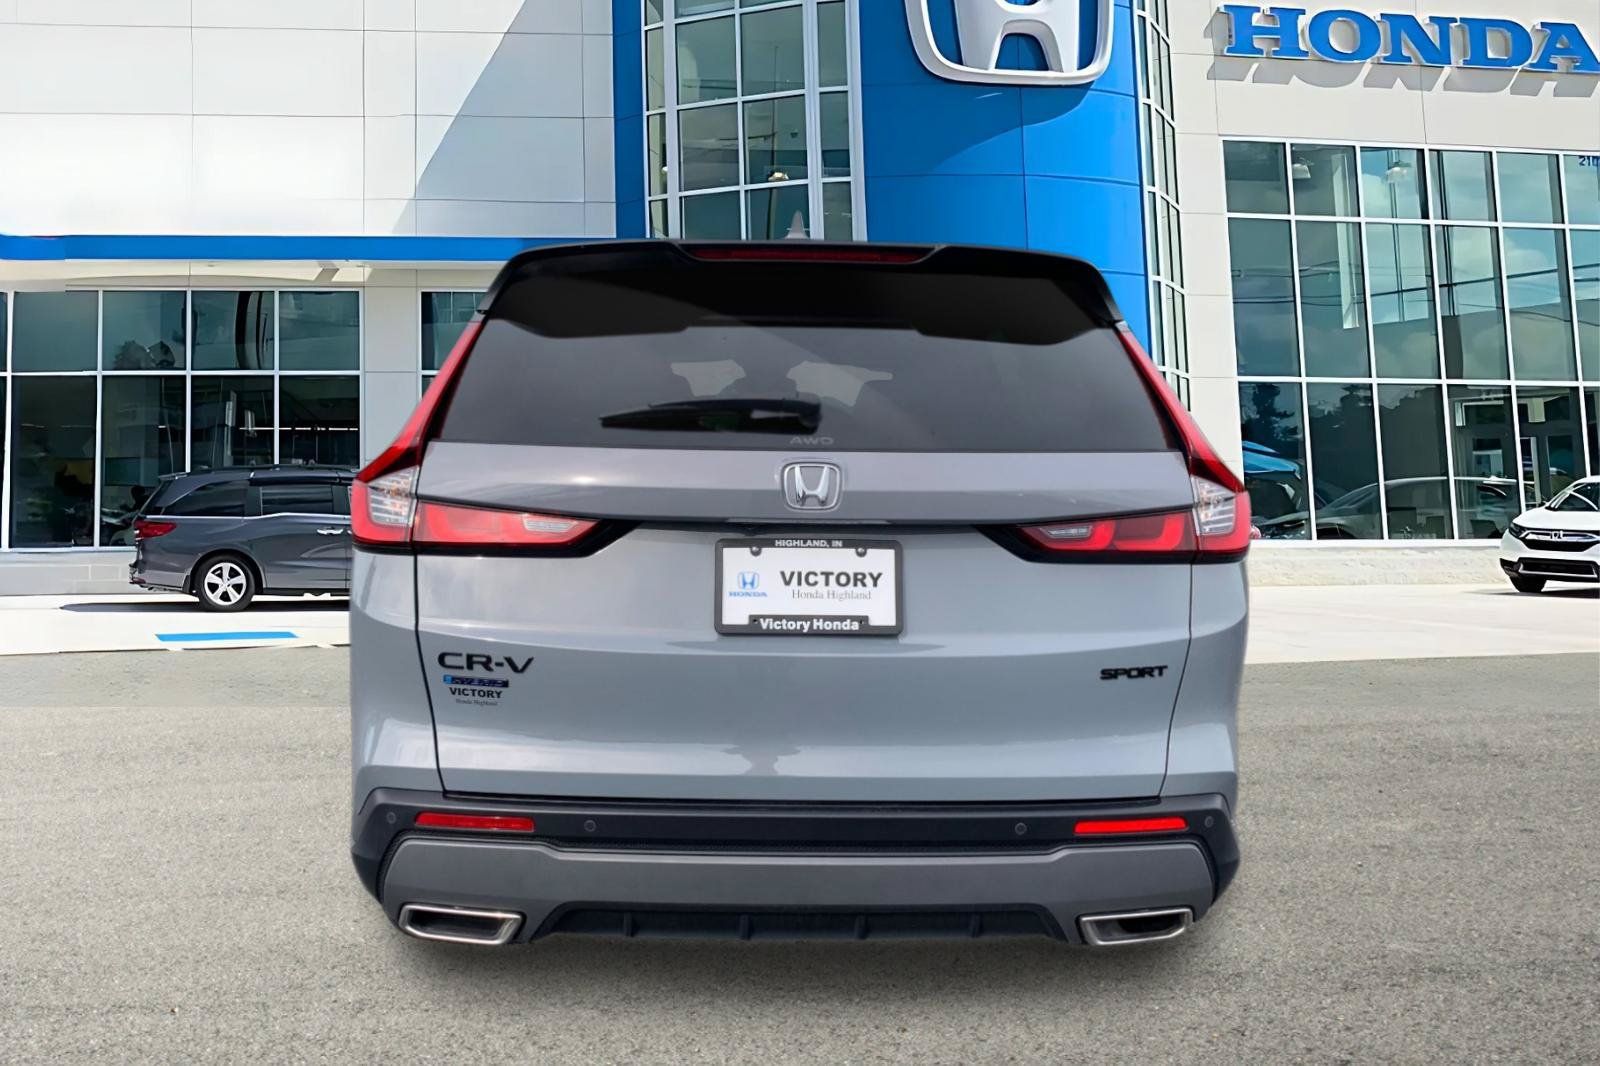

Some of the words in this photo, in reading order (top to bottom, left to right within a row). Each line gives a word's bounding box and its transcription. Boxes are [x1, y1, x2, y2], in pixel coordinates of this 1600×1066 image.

[1223, 4, 1600, 73] HONDA
[789, 436, 835, 445] AWD
[775, 539, 829, 548] HIGHLAND,
[780, 570, 883, 588] VICTORY
[792, 588, 824, 600] Honda
[827, 589, 872, 602] Highland
[759, 617, 811, 633] Victory
[813, 618, 859, 631] Honda
[437, 652, 535, 674] CR-V
[1100, 665, 1168, 680] SPORT
[449, 687, 502, 699] VICTORY
